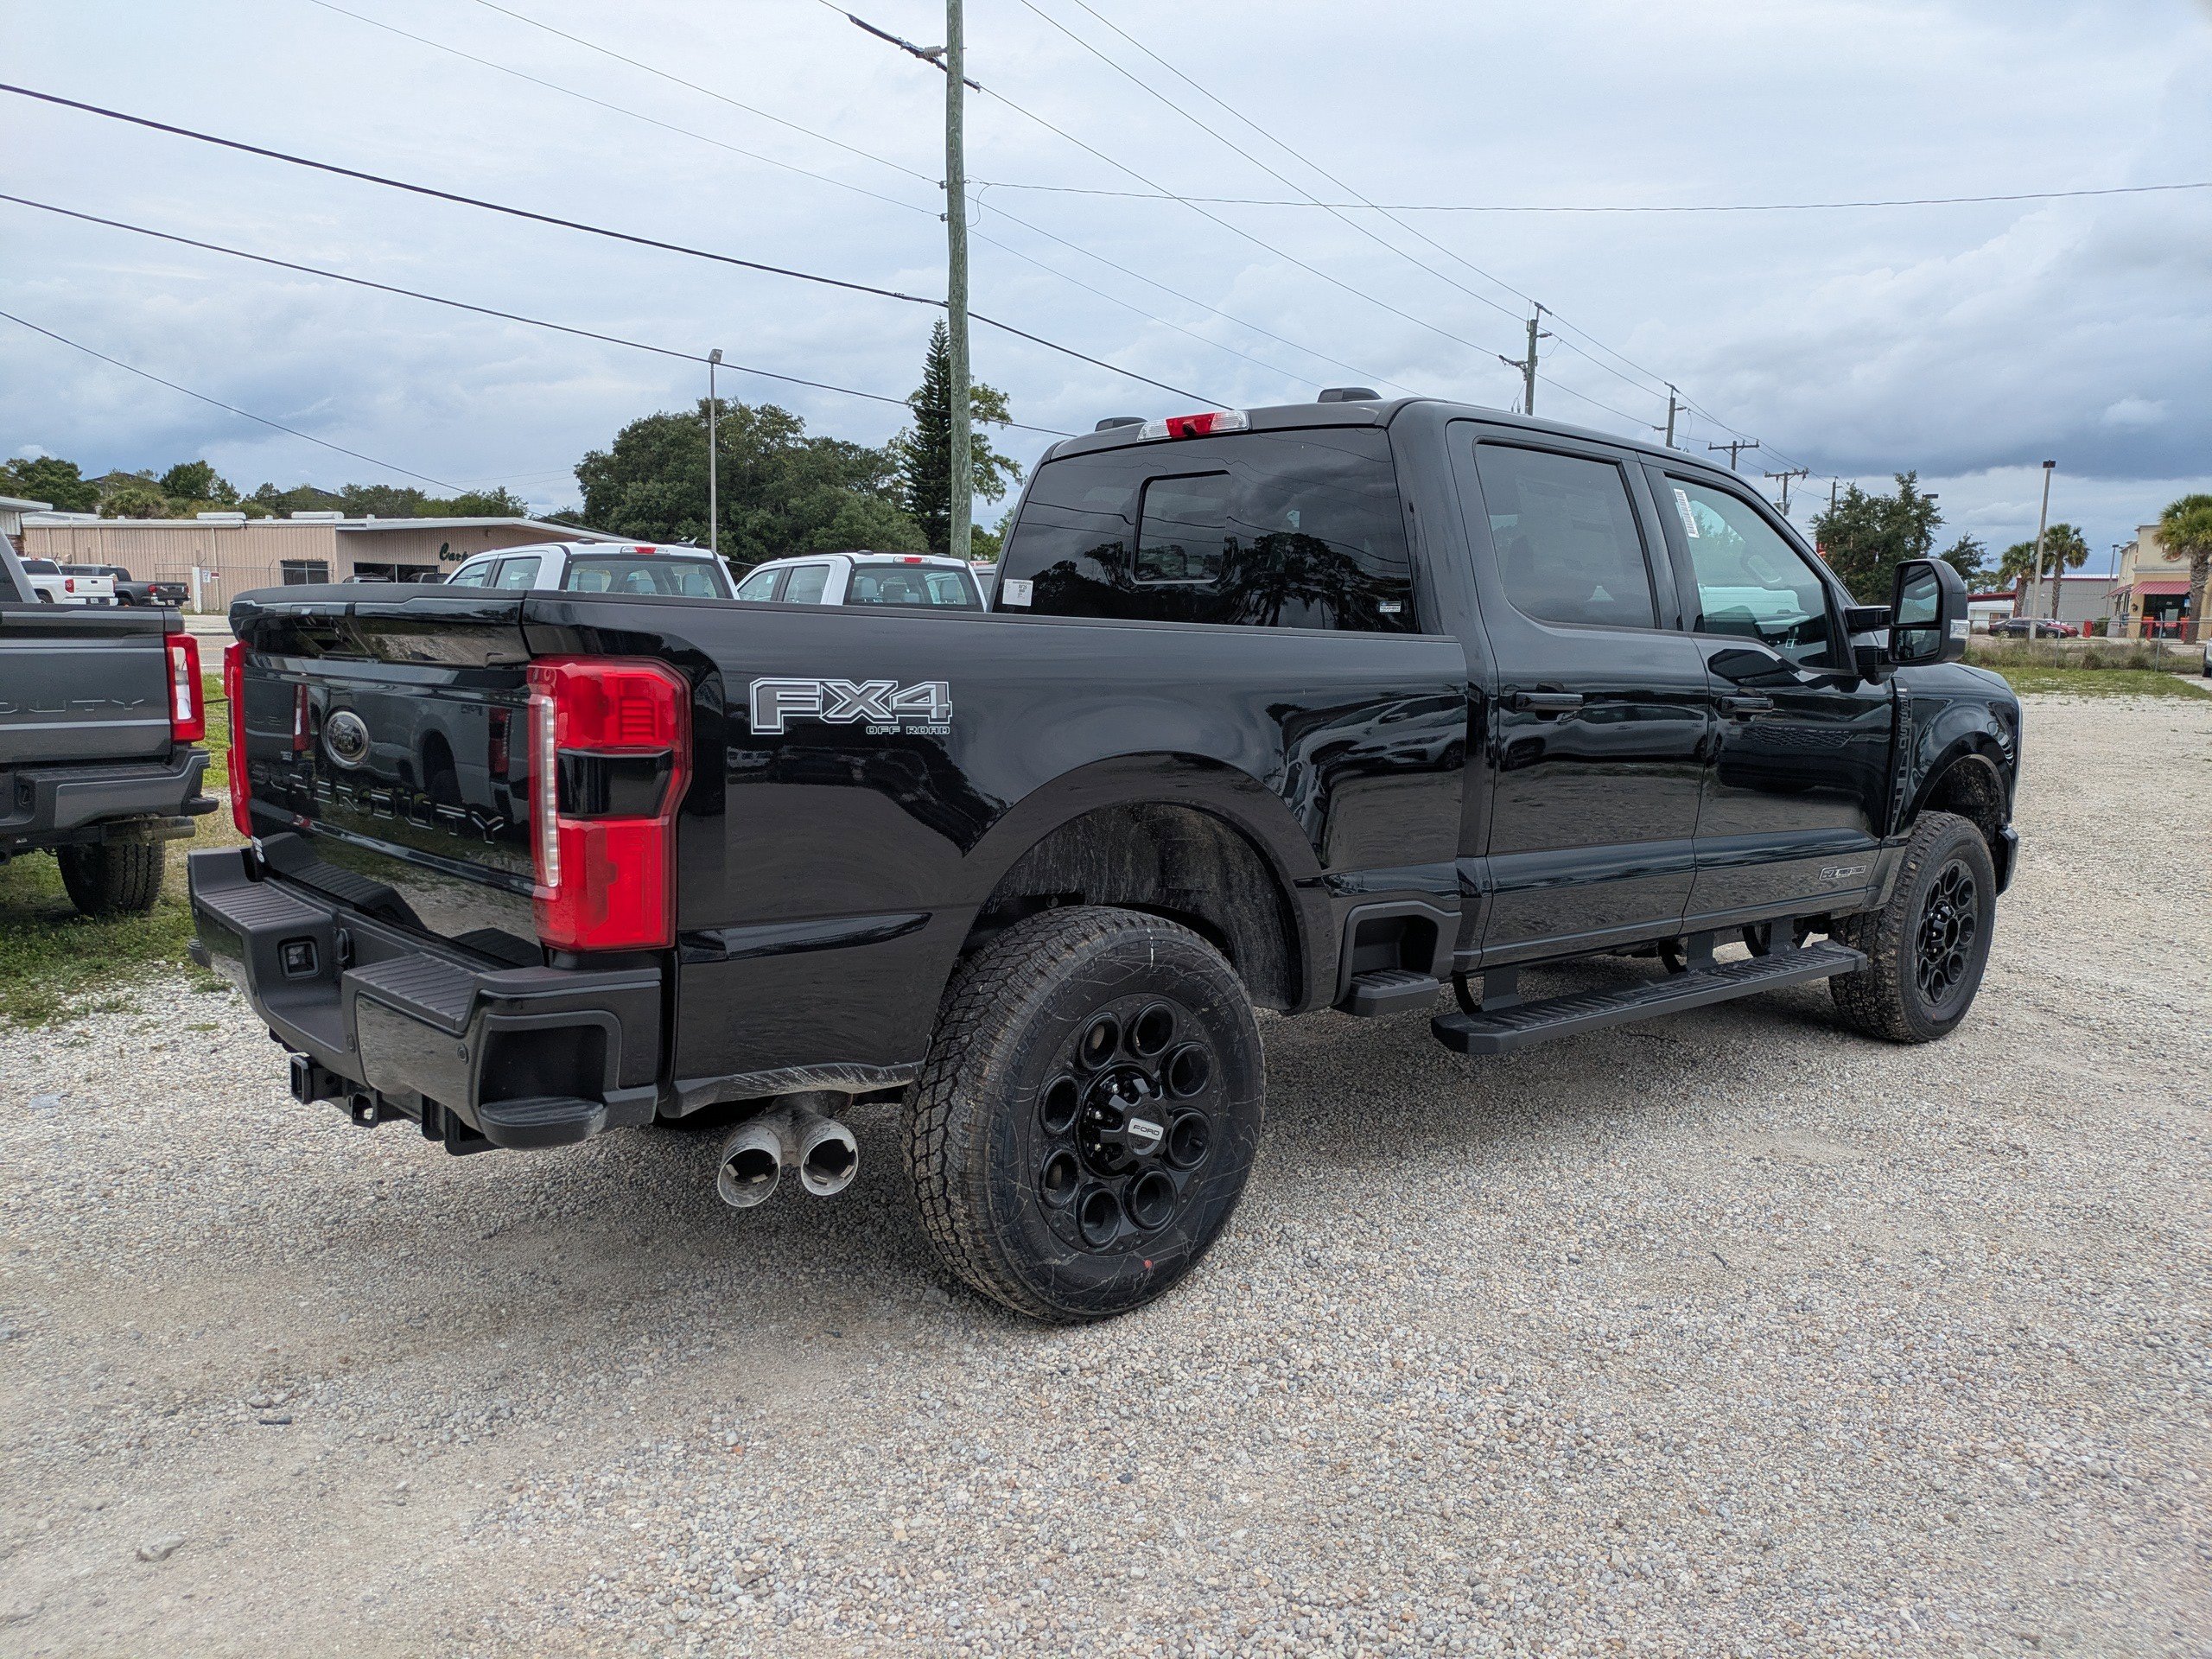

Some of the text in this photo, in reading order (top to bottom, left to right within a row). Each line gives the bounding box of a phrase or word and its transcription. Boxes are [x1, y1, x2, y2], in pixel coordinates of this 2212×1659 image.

[749, 677, 952, 734] FX4
[866, 726, 950, 735] OFF ROAD
[1133, 1124, 1160, 1136] FORD
